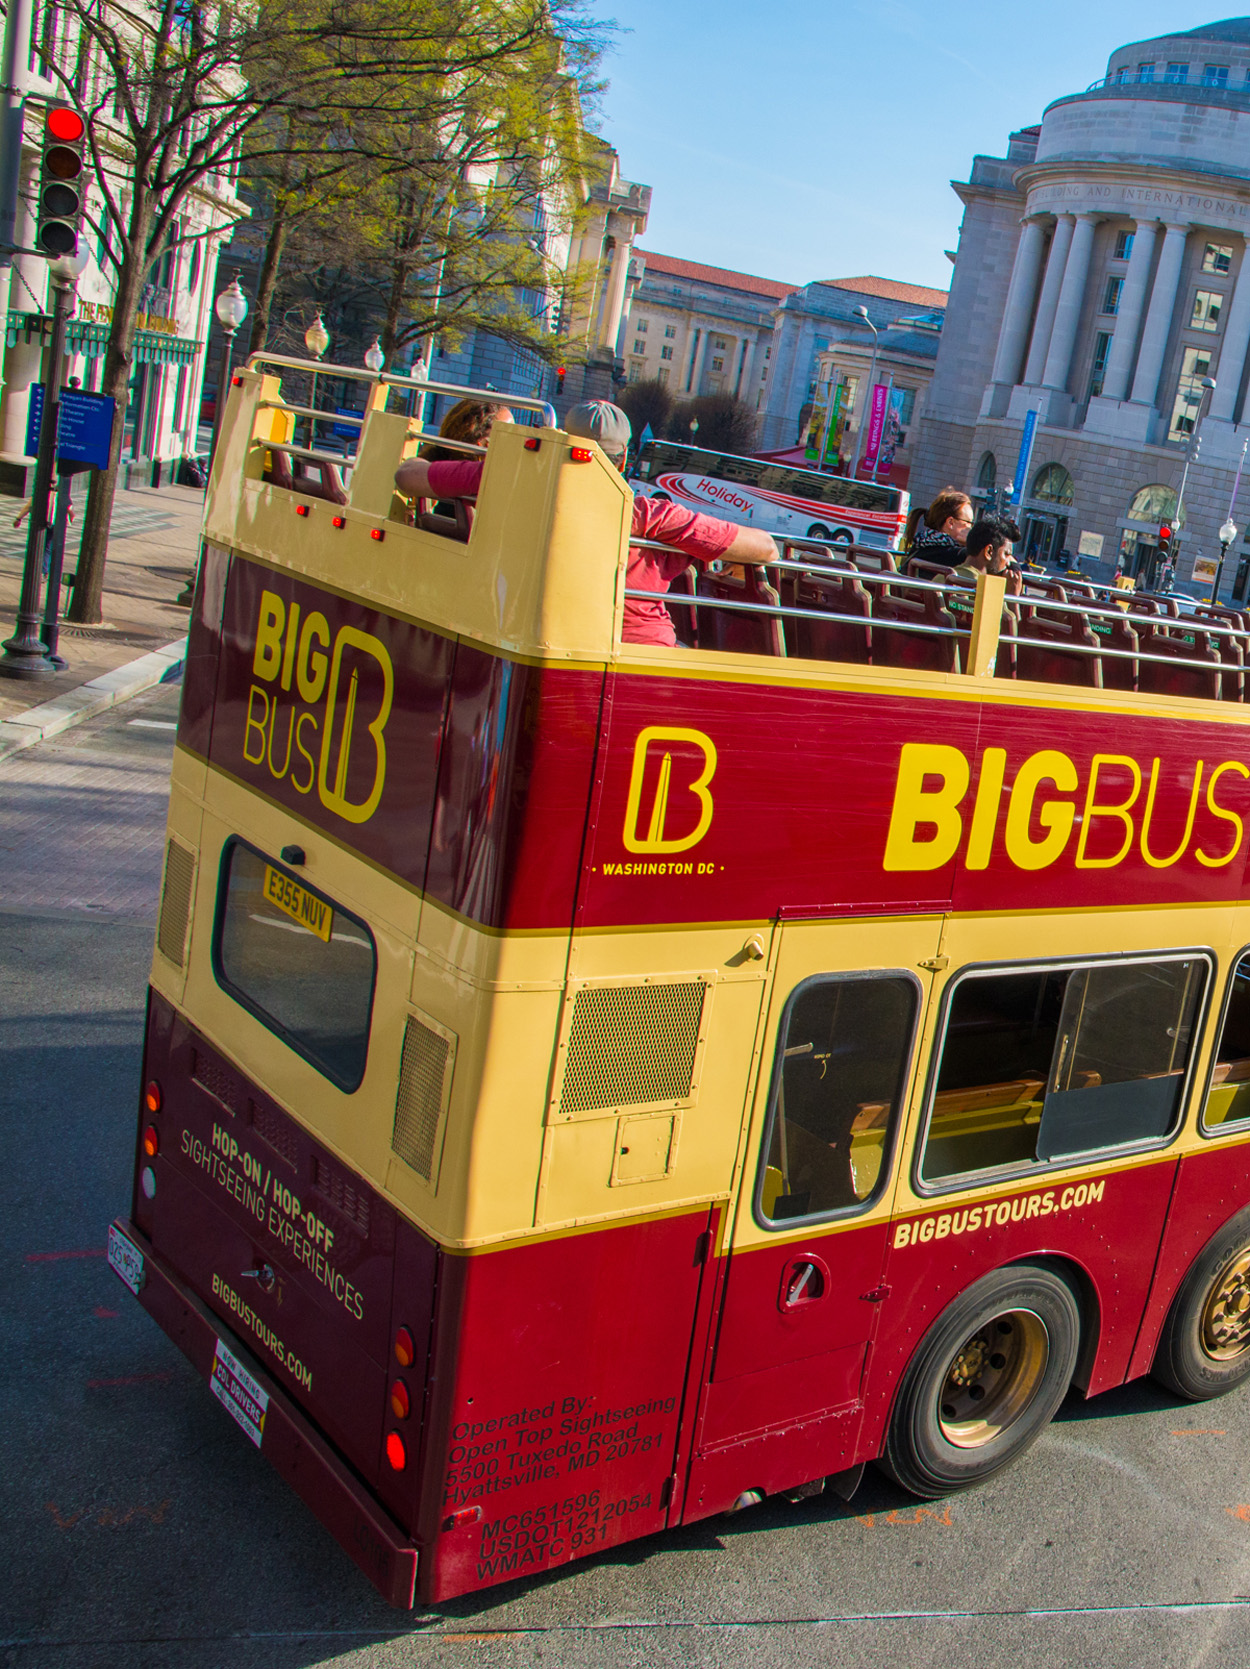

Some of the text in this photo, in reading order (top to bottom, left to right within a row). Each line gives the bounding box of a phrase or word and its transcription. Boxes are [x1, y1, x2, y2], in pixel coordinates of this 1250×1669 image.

[1088, 187, 1111, 198] AND
[1121, 187, 1248, 217] INTERNATIONAL
[696, 478, 754, 513] Holiday
[957, 604, 975, 614] STAND
[253, 589, 330, 704] BIG
[243, 684, 318, 794] BUS
[268, 870, 327, 931] E355 NUV
[602, 862, 715, 876] WASHINGTON DC
[181, 1129, 266, 1222] SIGHTSEEING
[212, 1122, 335, 1253] HOP-ON / HOP-OFF
[893, 1180, 1106, 1249] BIGBUSTOURS.COM
[269, 1206, 365, 1320] EXPERIENCES
[211, 1272, 313, 1392] BIGBUSTOURS.COM
[217, 1364, 261, 1423] CDL DRIVERS
[222, 1350, 260, 1400] NOW HIRING
[448, 1396, 677, 1465] Open Top Sightseeing
[452, 1395, 593, 1441] Operated By:
[442, 1432, 663, 1507] Hyattsville, MD 20781
[444, 1422, 639, 1488] 5500 Tuxedo Road
[479, 1492, 653, 1560] USDOT1212054
[481, 1489, 601, 1541] MC651596
[476, 1523, 607, 1581] WMATC 931
